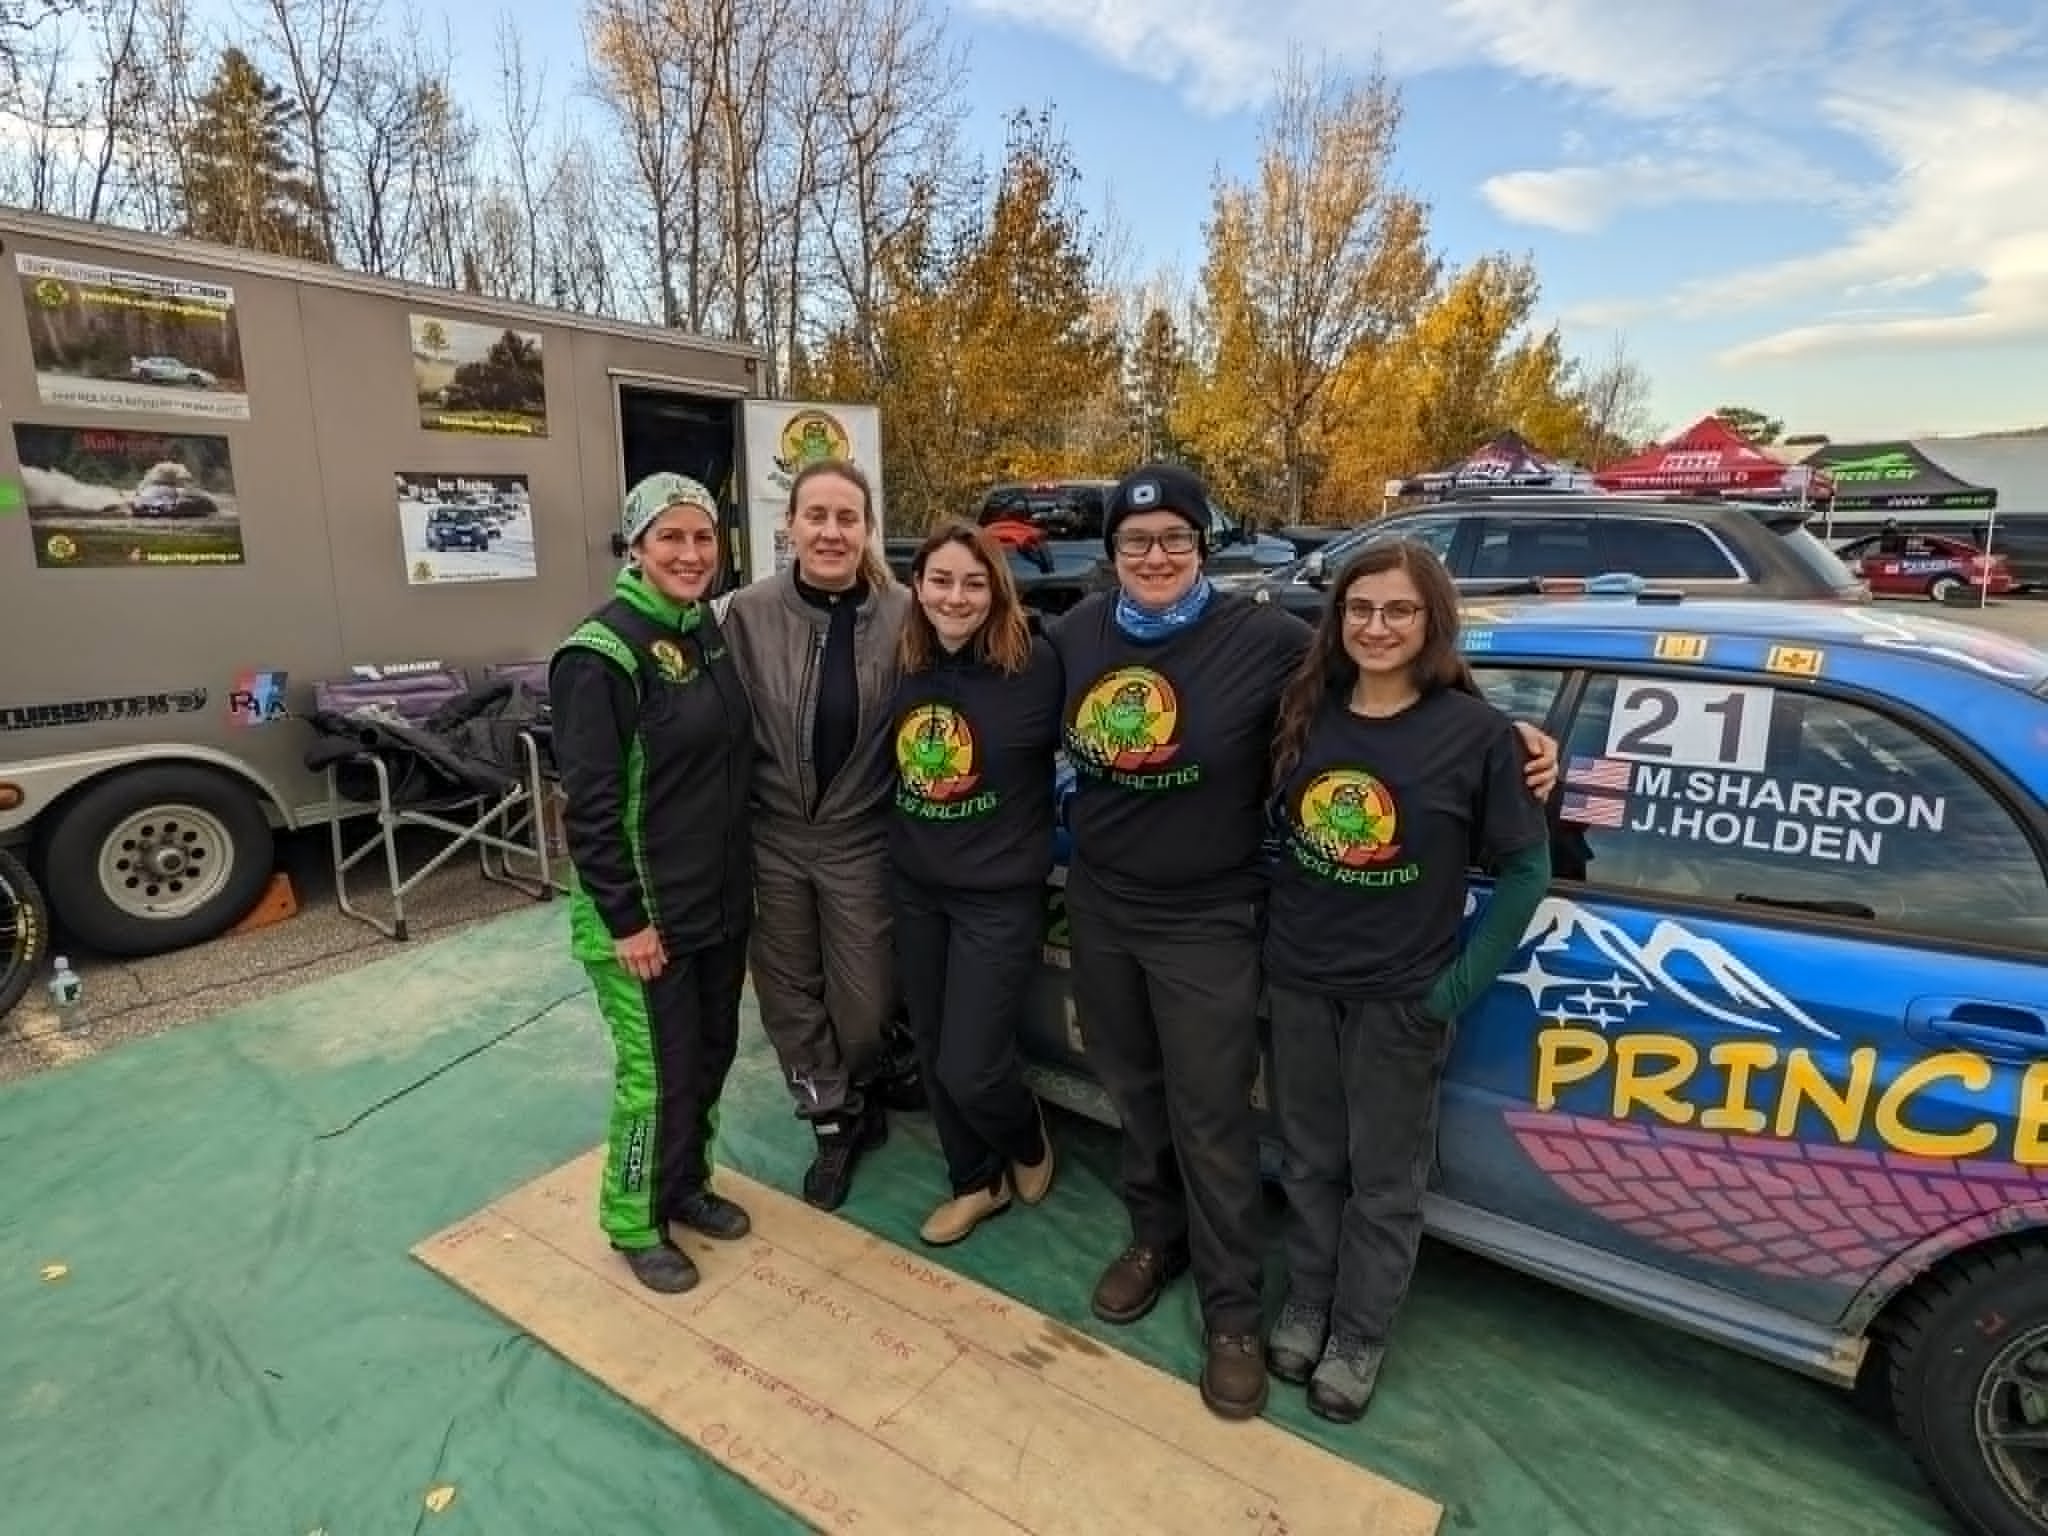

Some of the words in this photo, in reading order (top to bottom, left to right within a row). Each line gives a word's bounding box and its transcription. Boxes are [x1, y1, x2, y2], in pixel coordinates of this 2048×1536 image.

[1616, 687, 1746, 763] 21
[1634, 765, 1946, 832] M.SHARRON
[1630, 802, 1883, 866] J.HOLDEN
[889, 1254, 958, 1294] UNDER
[699, 1422, 862, 1527] OUTSIDE
